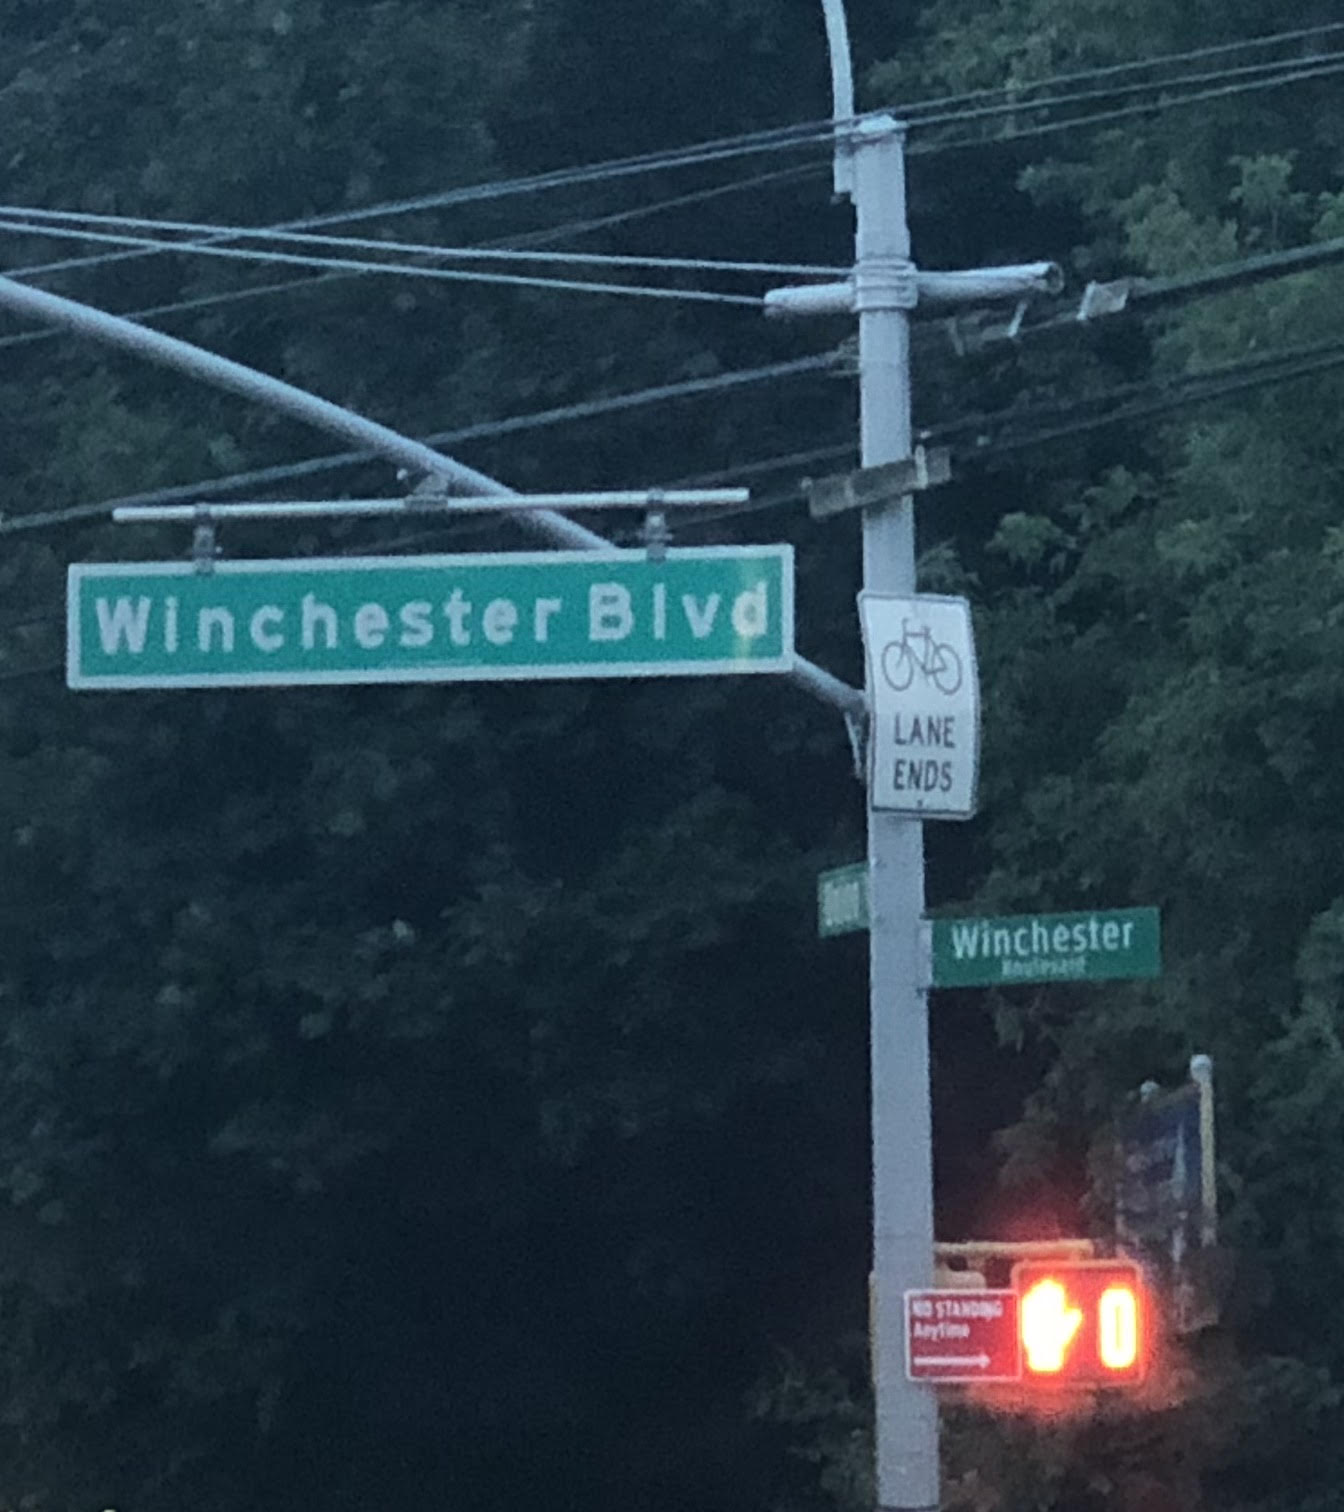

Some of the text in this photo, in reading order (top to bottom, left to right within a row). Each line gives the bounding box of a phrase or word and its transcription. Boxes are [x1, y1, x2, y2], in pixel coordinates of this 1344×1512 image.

[96, 581, 768, 655] Winchester Blvd
[894, 714, 956, 750] LANE
[894, 759, 953, 793] ENDS
[951, 918, 1134, 960] Winchester
